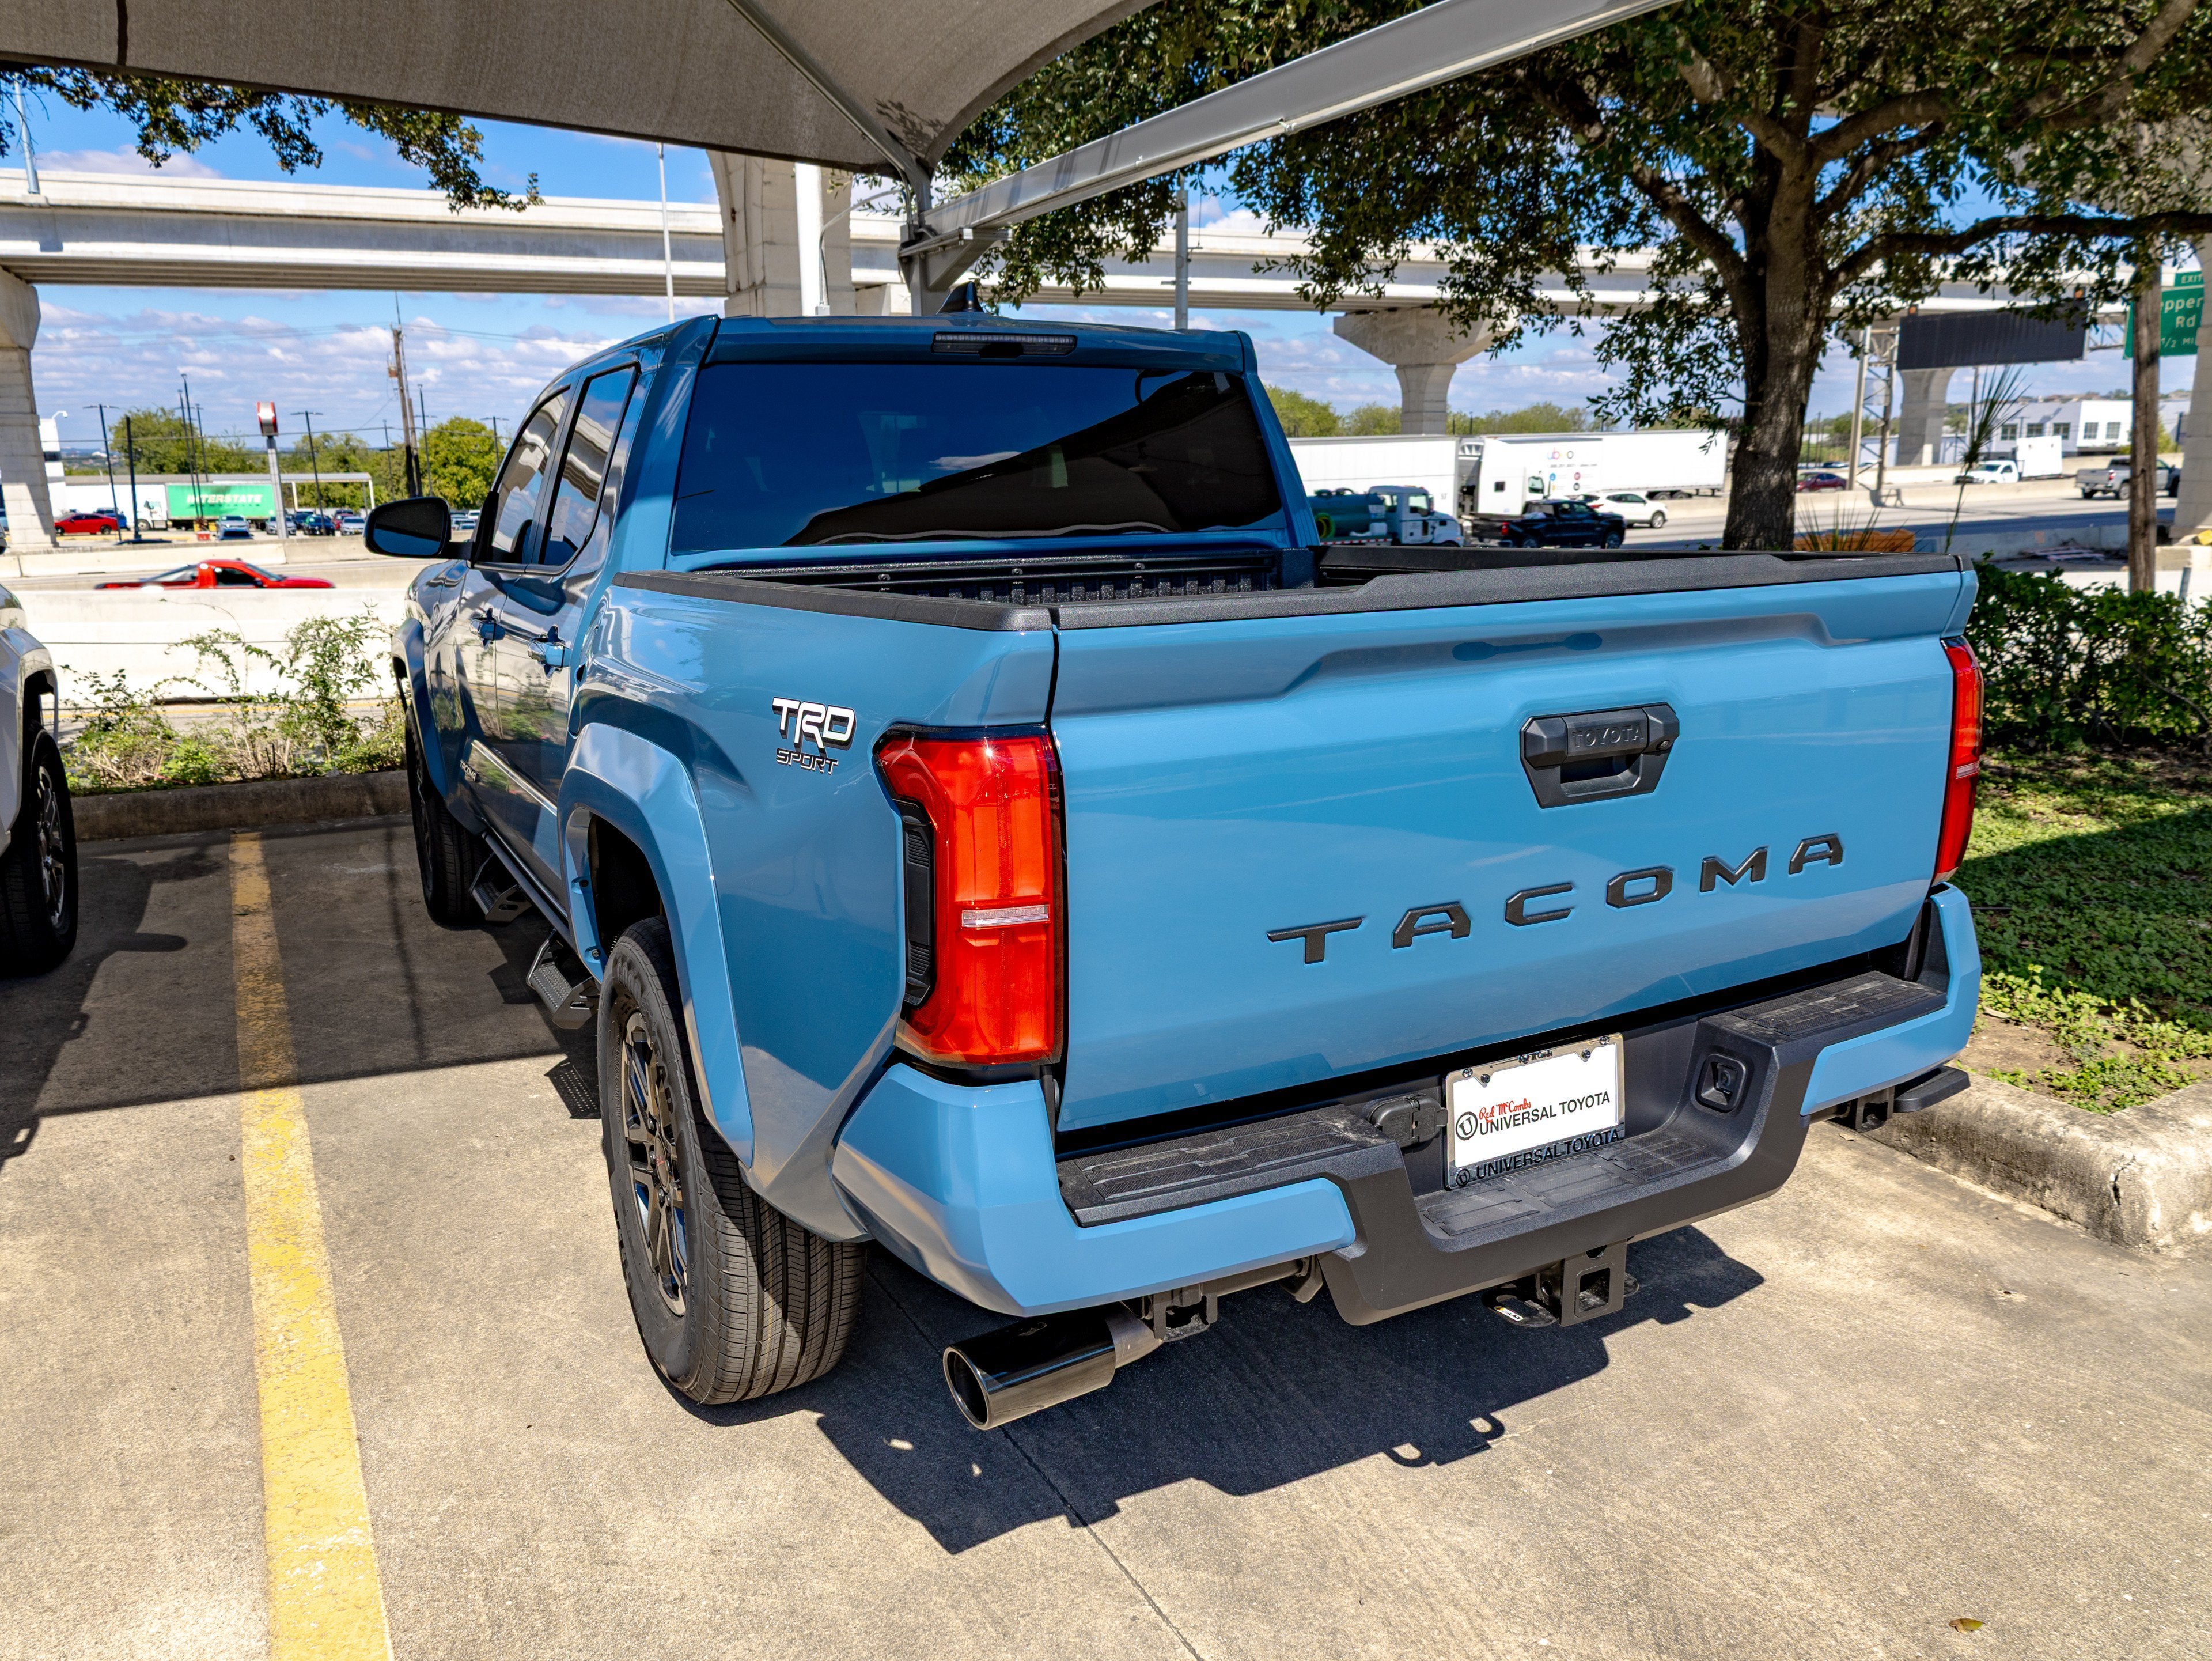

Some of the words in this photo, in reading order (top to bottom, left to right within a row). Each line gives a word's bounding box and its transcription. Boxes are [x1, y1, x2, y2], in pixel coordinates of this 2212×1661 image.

[2181, 274, 2203, 284] EXIT
[2176, 315, 2196, 328] Rd
[186, 494, 263, 504] INTERSTATE
[772, 697, 857, 752] TRD
[1572, 724, 1645, 748] TOYOTA
[460, 759, 476, 782] TACOMA
[776, 748, 839, 775] SPORT
[1267, 833, 1845, 965] TACOMA
[1479, 1106, 1495, 1122] Red
[1496, 1098, 1532, 1115] McCombs
[1479, 1104, 1557, 1135] UNIVERSAL
[1559, 1091, 1611, 1115] TOYOTA
[1476, 1145, 1562, 1180] UNIVERSAL
[1564, 1127, 1622, 1155] TOYOTA
